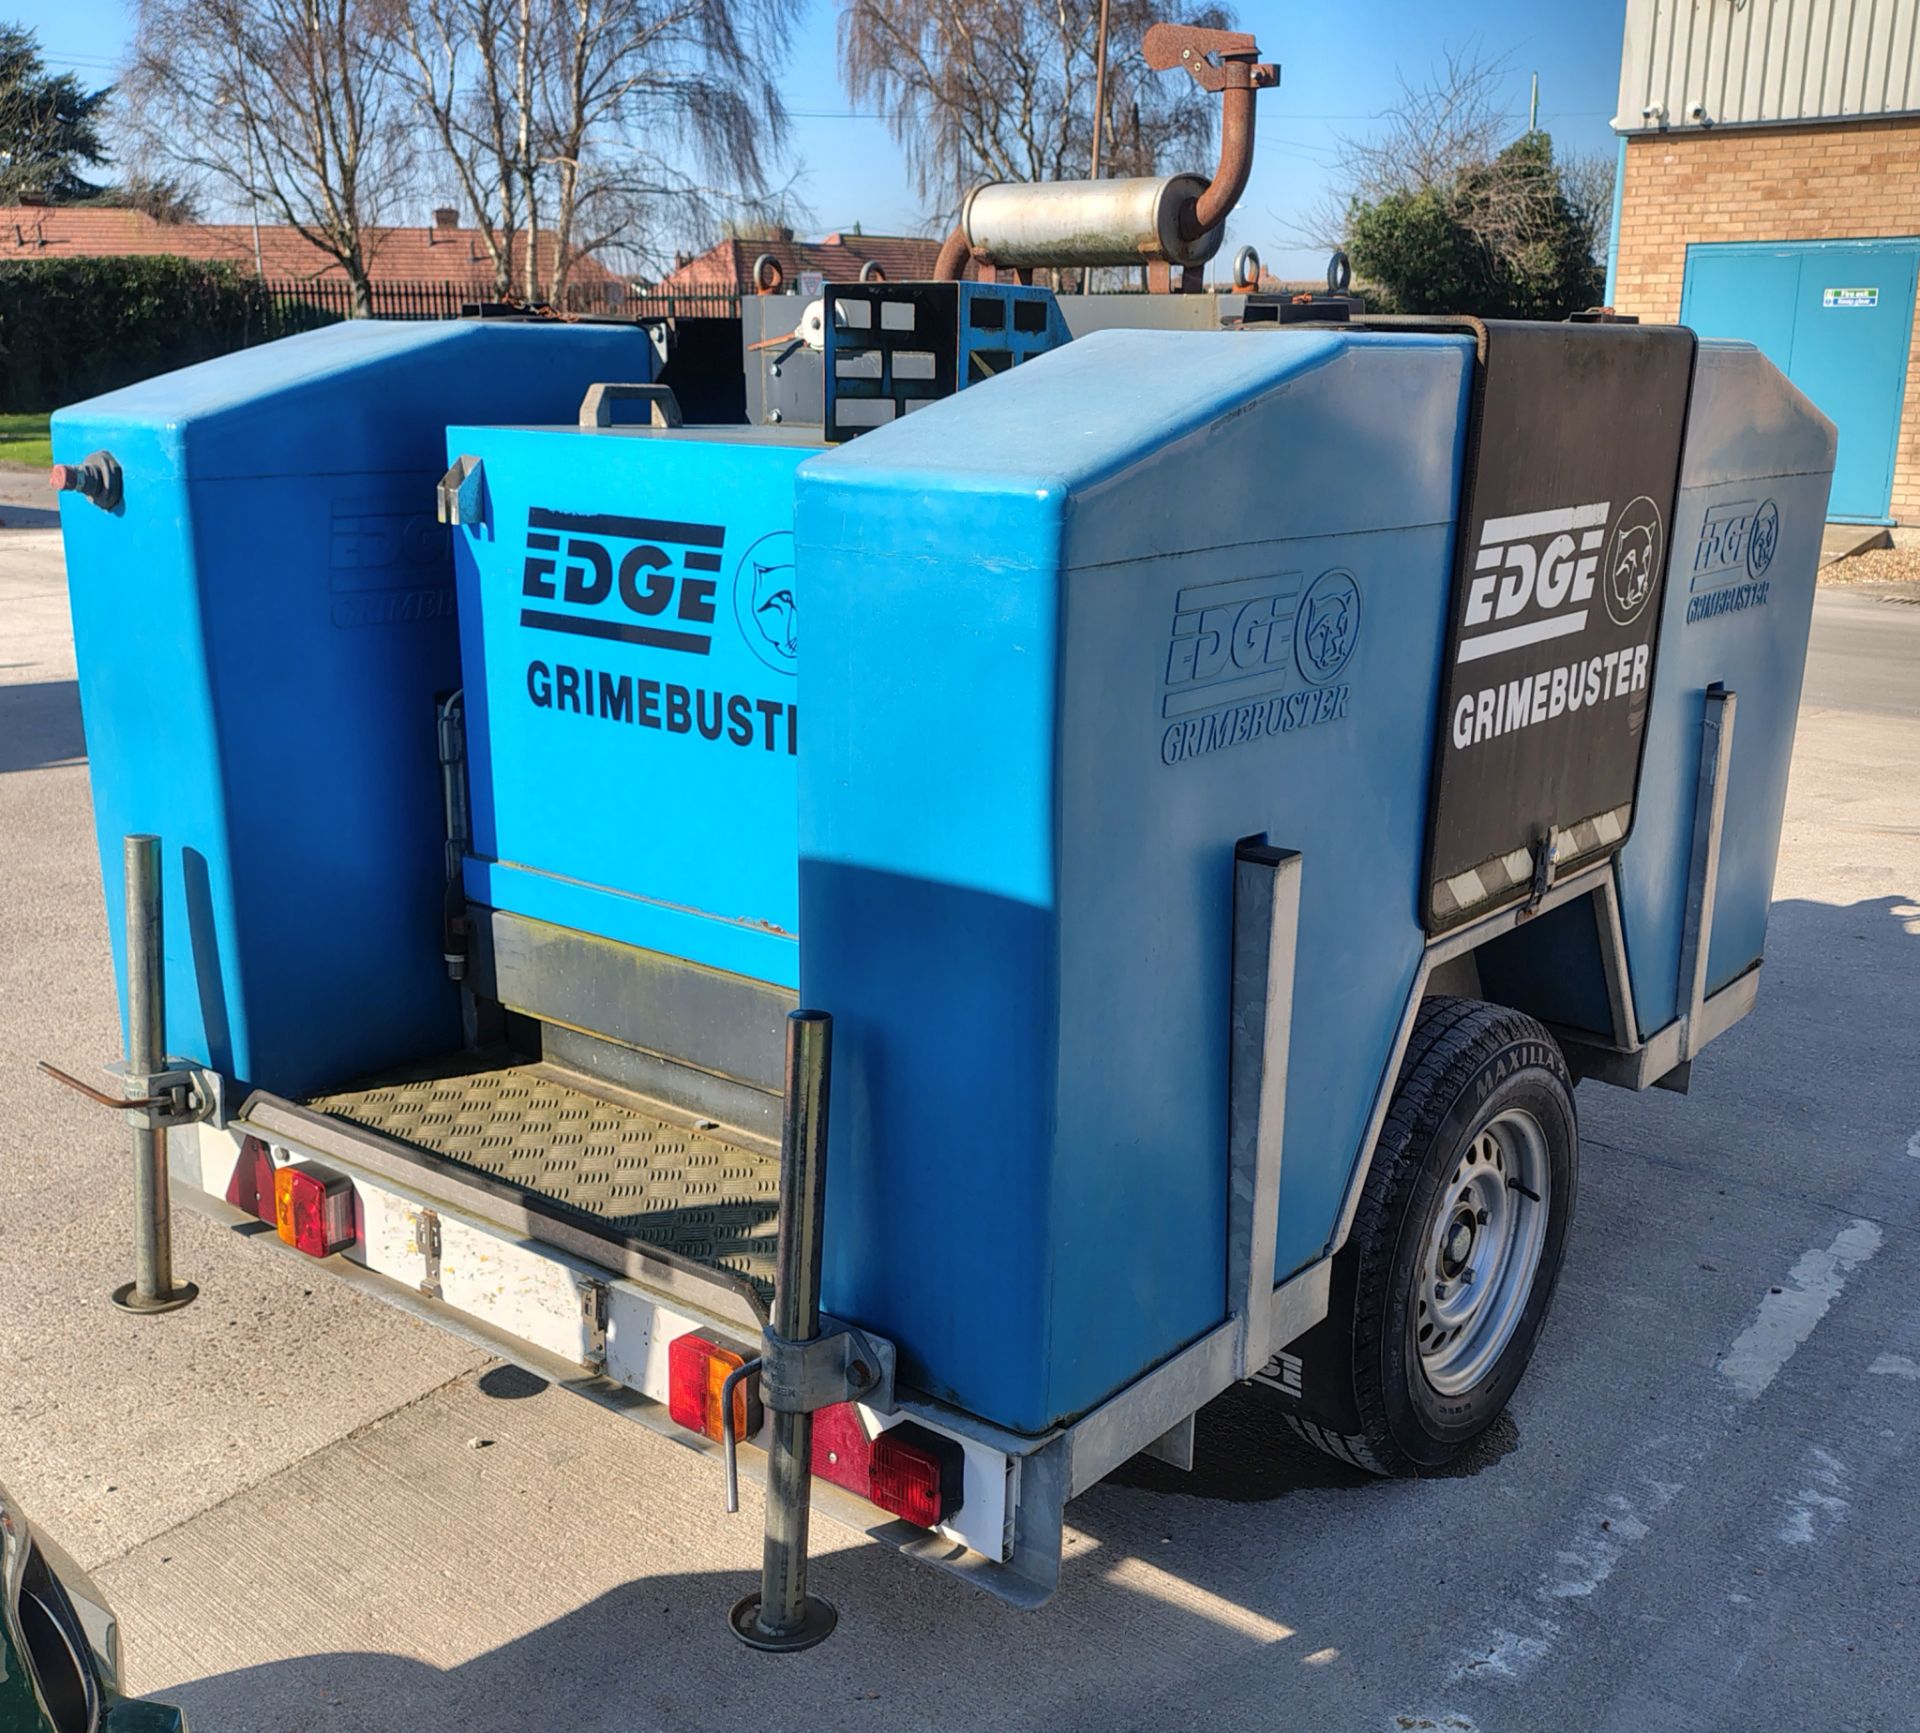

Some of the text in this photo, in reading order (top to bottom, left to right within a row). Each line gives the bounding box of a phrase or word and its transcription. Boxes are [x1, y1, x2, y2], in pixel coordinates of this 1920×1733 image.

[522, 532, 721, 624] EDGE
[1464, 529, 1604, 627] EDGE
[1165, 592, 1299, 685] EDGE
[1161, 683, 1351, 766] GRIMEBUSTER
[1452, 643, 1650, 750] GRIMEBUSTER
[1476, 1046, 1554, 1104] MAXILLA
